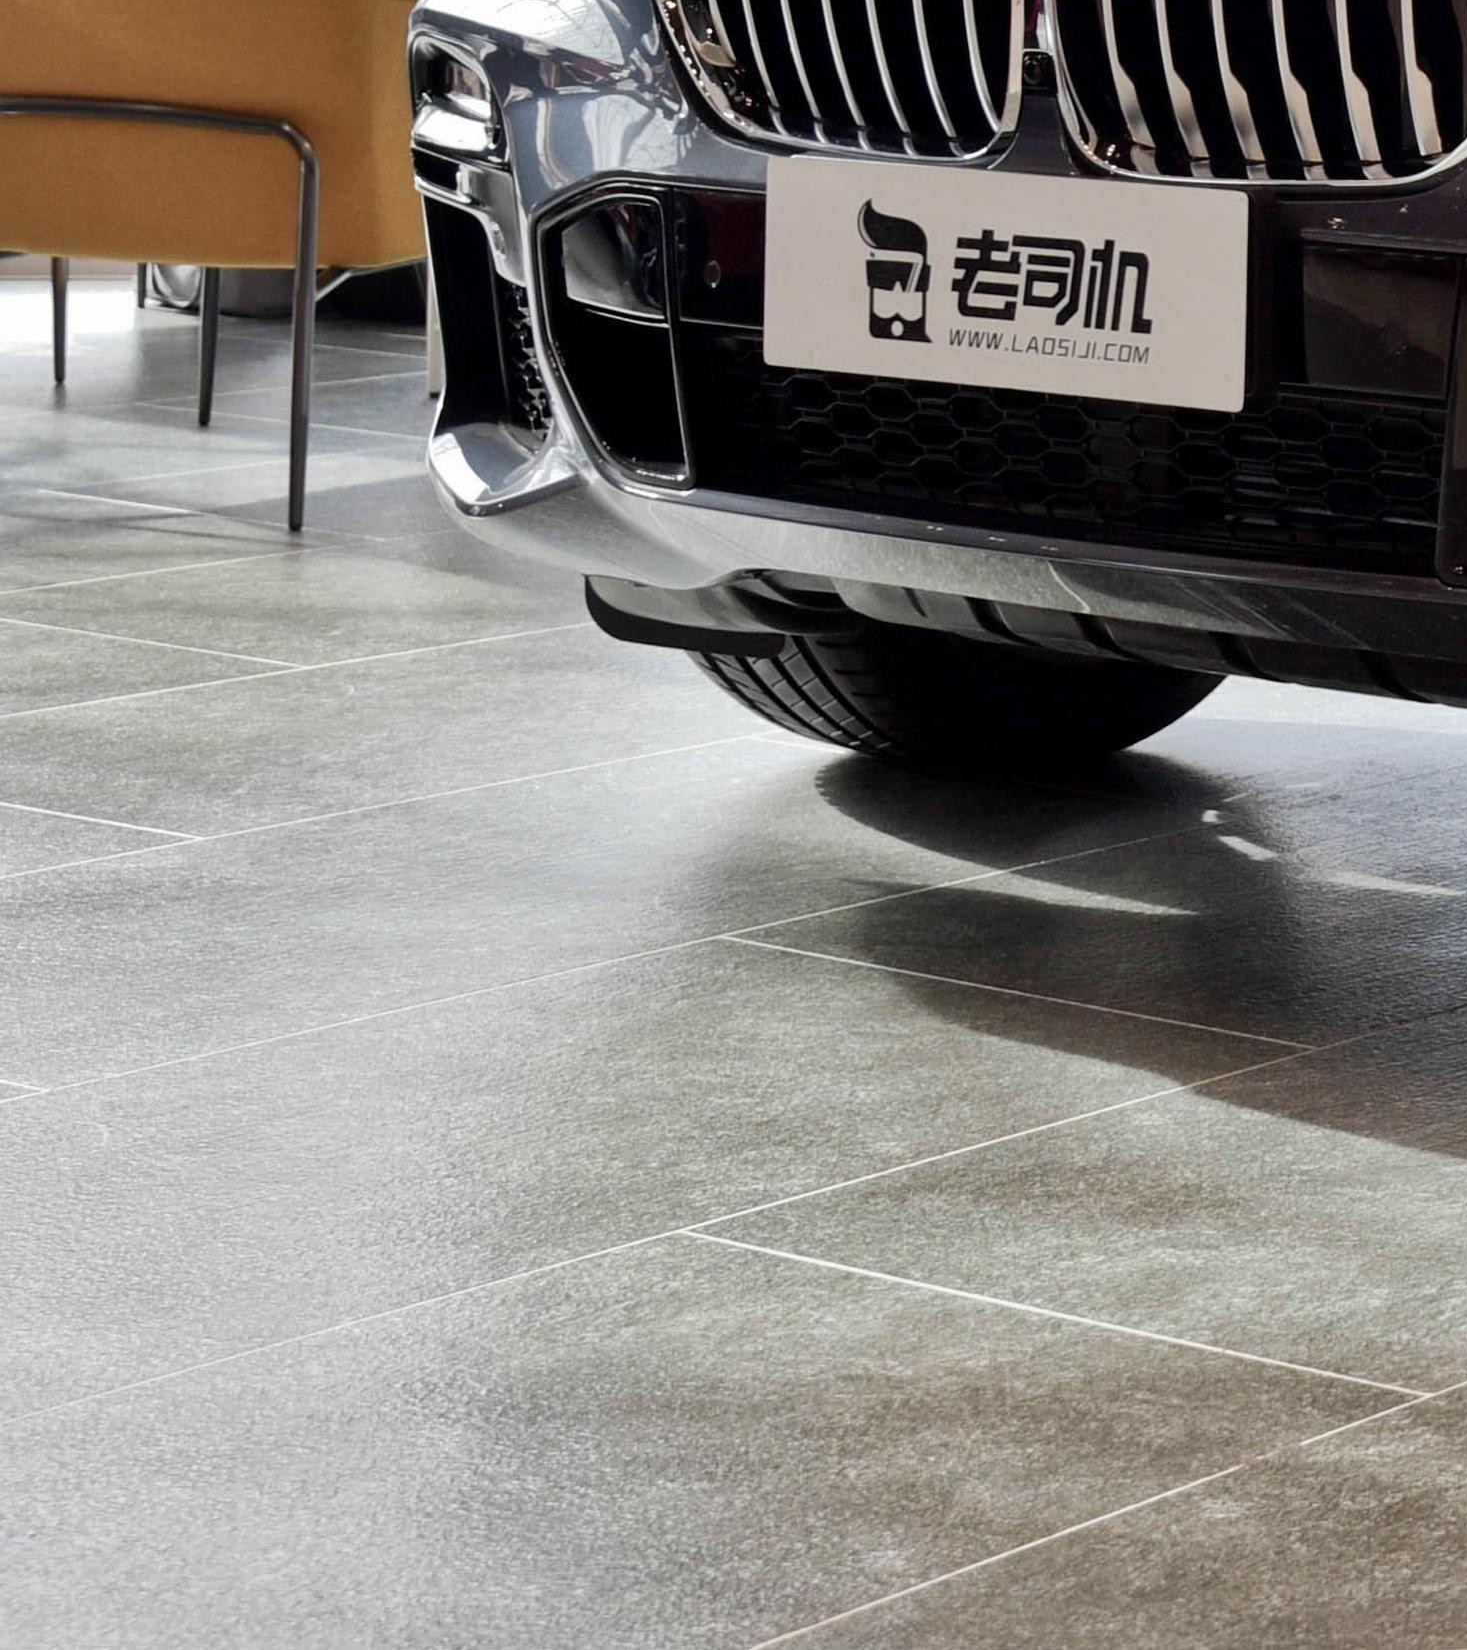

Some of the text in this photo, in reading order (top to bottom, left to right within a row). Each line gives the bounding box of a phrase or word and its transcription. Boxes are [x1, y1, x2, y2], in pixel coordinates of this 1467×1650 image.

[951, 229, 1152, 334] 老司机
[949, 328, 1150, 365] WWW.LAOSIJI.COM
